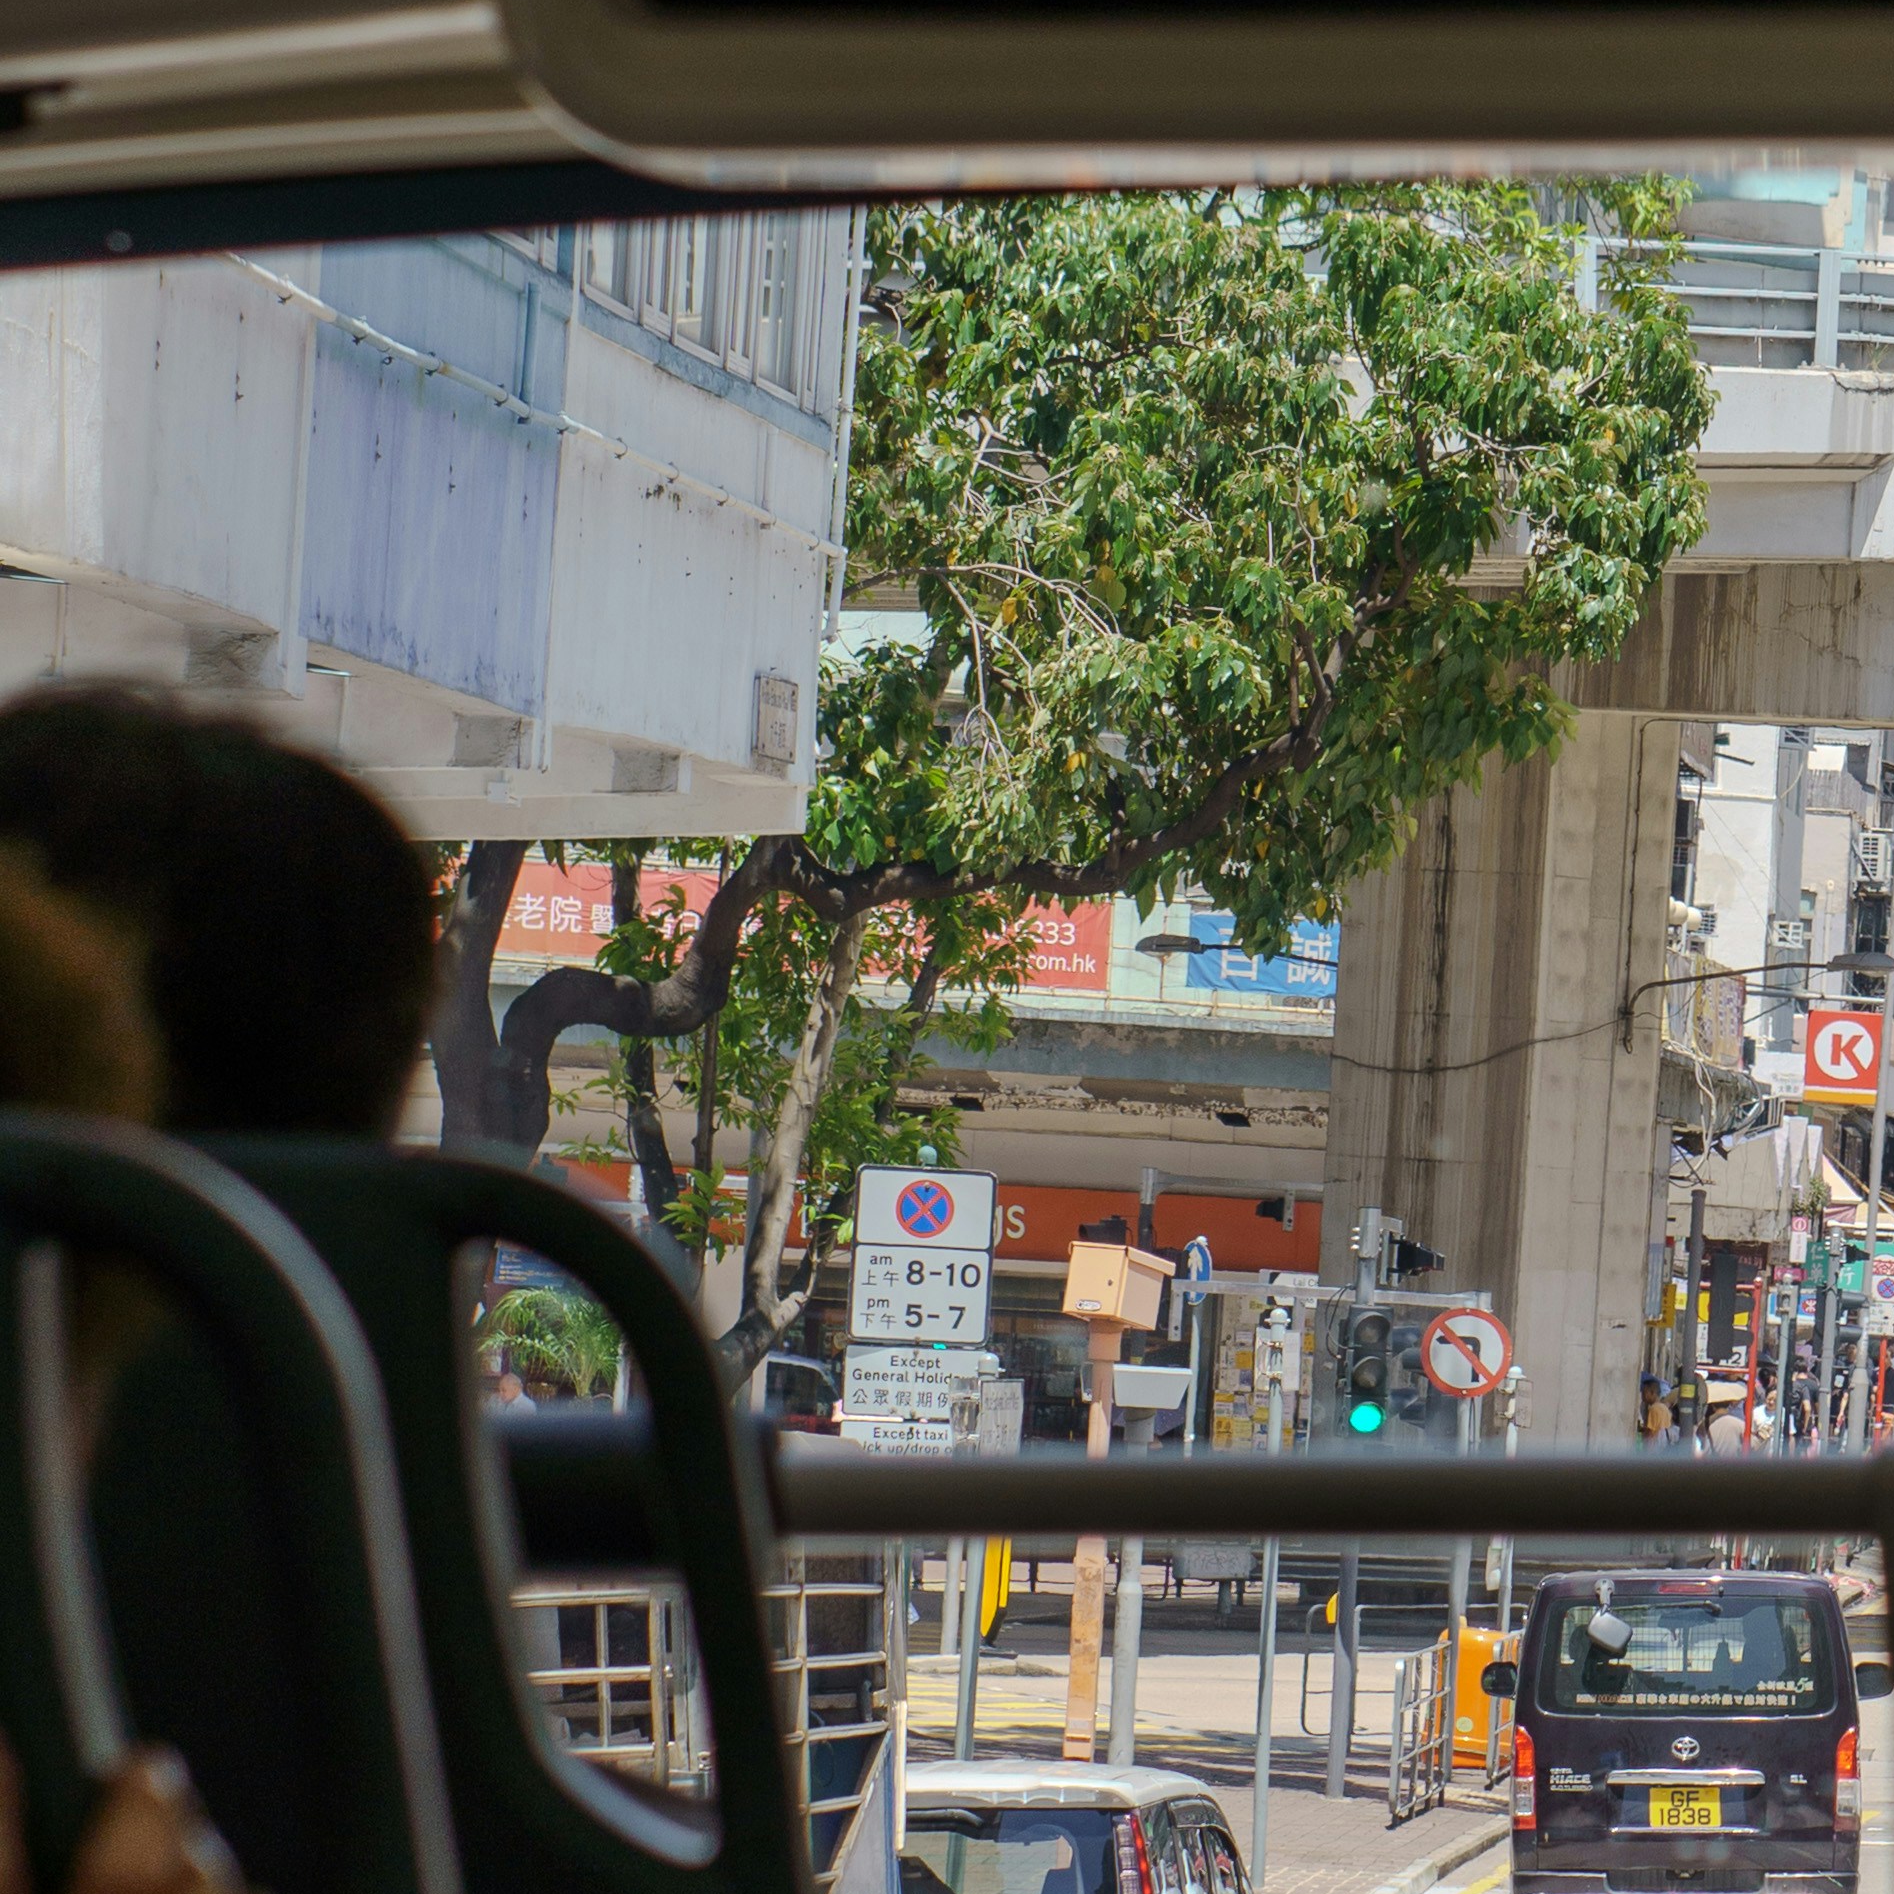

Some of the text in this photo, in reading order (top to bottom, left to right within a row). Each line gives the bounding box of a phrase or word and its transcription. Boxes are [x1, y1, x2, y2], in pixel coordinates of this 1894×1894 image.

[1830, 1033, 1867, 1070] K
[870, 1254, 893, 1266] am
[861, 1269, 900, 1288] 上午
[906, 1260, 981, 1288] 8-10
[866, 1297, 890, 1309] pm
[859, 1312, 897, 1330] 下午
[890, 1355, 942, 1369] Except
[852, 1369, 910, 1383] General
[873, 1426, 949, 1440] Except taxi
[862, 1442, 882, 1454] ick
[1550, 1774, 1592, 1784] HIACE
[1670, 1790, 1700, 1807] GF
[1659, 1807, 1711, 1826] 1838
